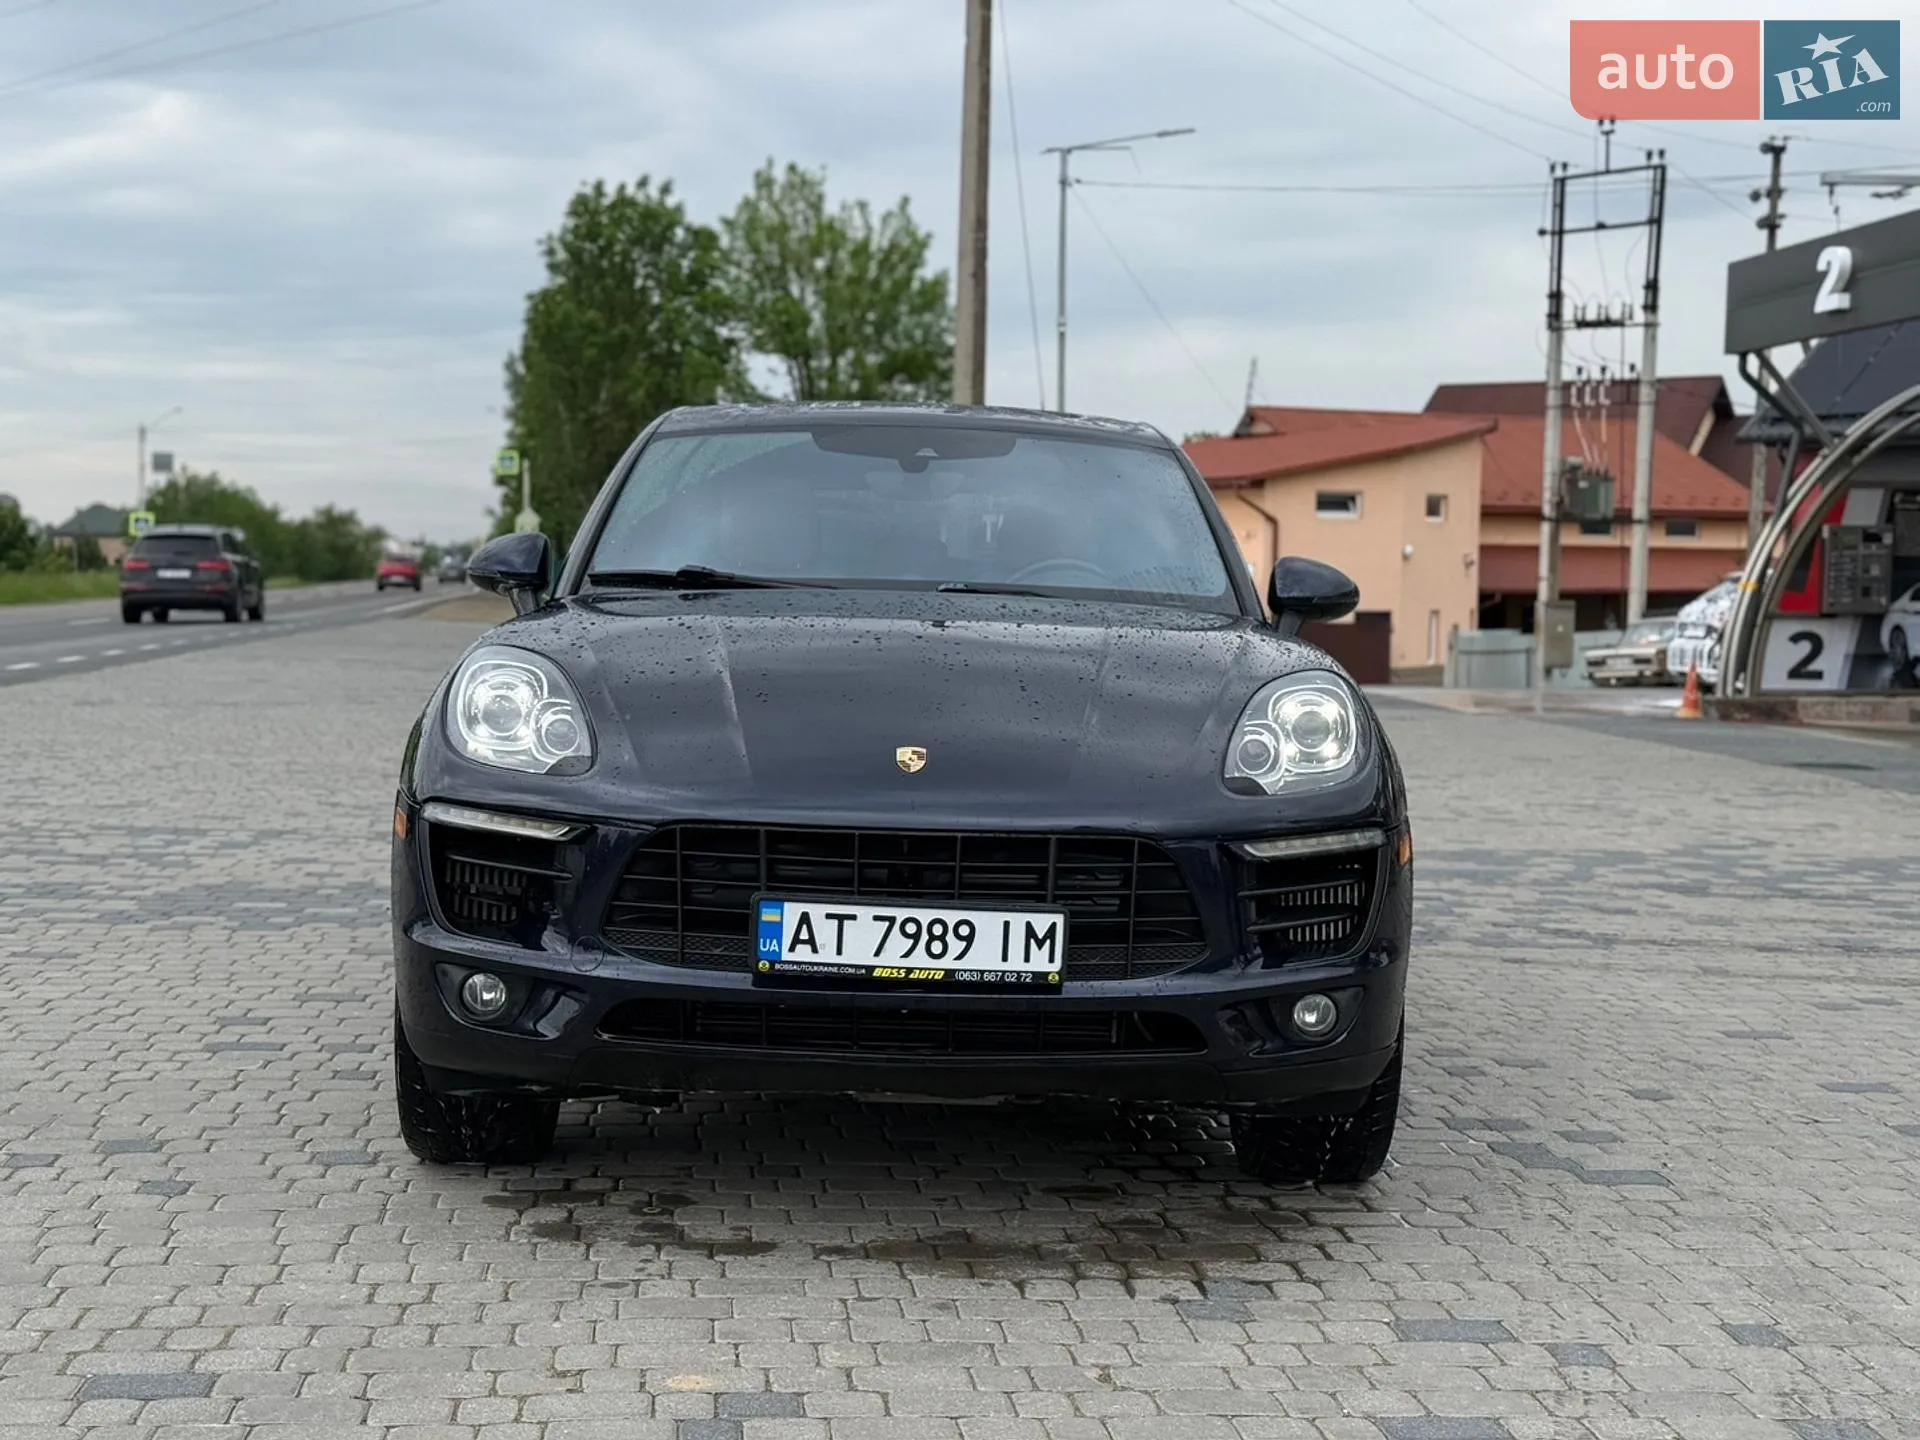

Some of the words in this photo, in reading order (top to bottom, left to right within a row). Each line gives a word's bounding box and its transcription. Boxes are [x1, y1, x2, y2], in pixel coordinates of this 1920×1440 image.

[1814, 245, 1852, 314] 2
[1787, 631, 1824, 680] 2
[759, 938, 779, 952] UA
[788, 911, 857, 956] AT
[872, 915, 977, 961] 7989
[1001, 920, 1057, 964] IM
[872, 967, 906, 978] BOSS
[909, 969, 945, 980] AUTO
[955, 972, 981, 982] (063)
[983, 973, 1002, 982] 667
[1005, 973, 1018, 983] 02
[1020, 973, 1033, 983] 72
